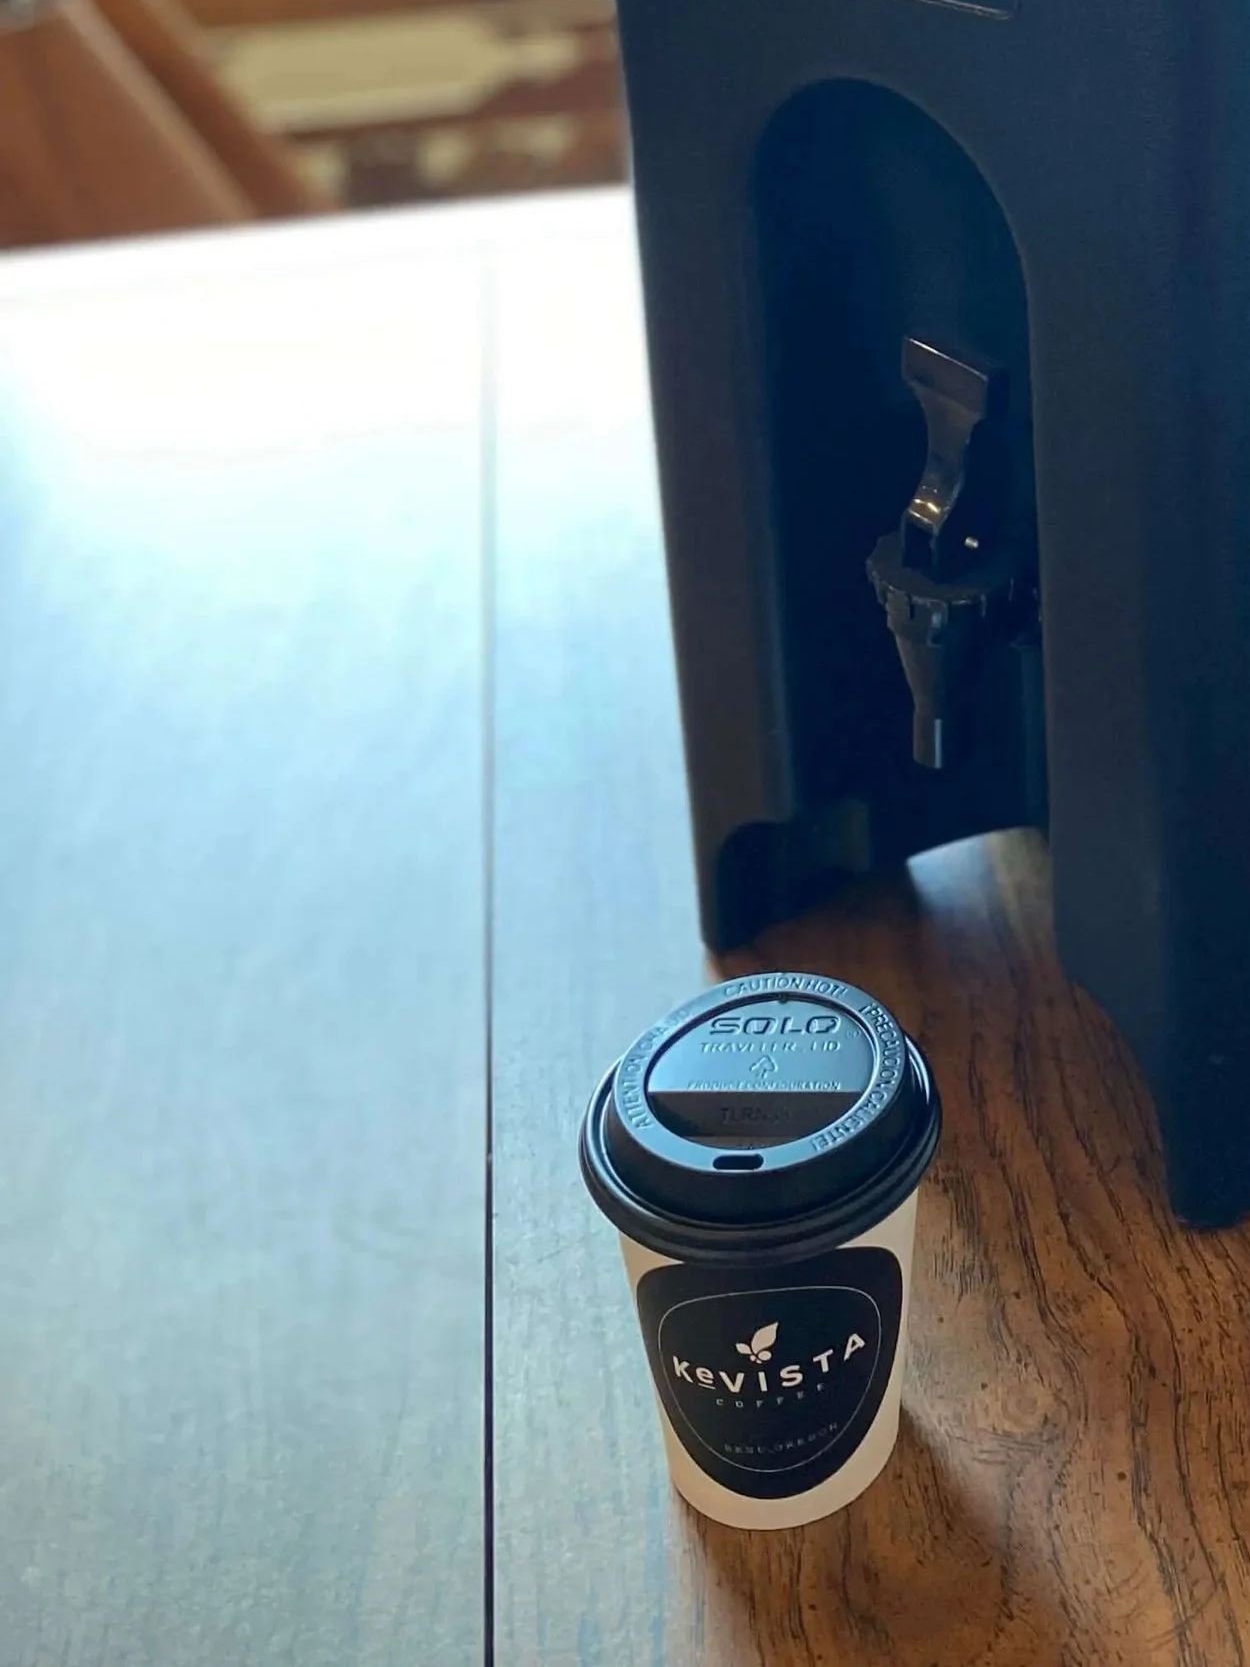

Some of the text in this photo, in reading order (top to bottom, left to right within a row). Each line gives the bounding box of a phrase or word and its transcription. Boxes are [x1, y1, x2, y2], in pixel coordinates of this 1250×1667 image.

[723, 976, 848, 999] CAUTION HOT!
[709, 1015, 842, 1037] SOLO
[621, 1055, 654, 1130] ATTENTION
[716, 1381, 827, 1409] COFFEE
